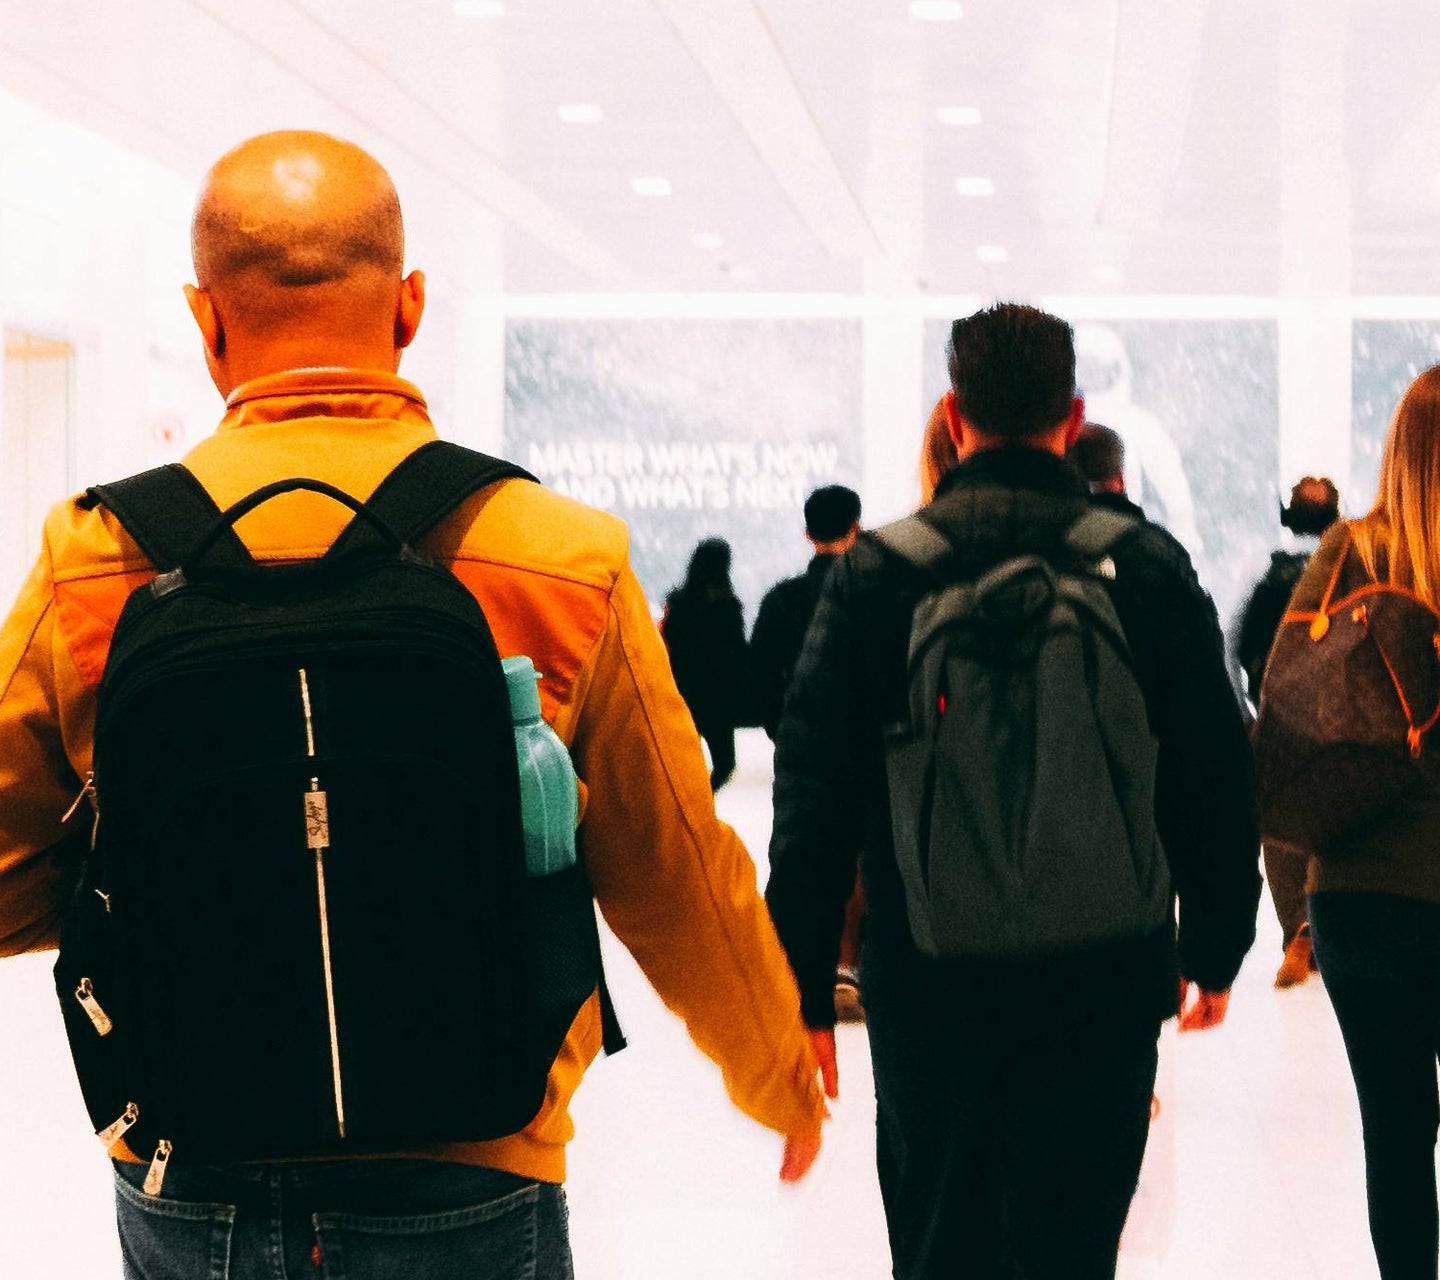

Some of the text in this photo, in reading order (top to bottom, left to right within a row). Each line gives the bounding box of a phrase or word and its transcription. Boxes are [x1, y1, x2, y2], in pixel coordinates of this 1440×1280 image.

[530, 442, 839, 477] MASTER WHAT'S NOW
[554, 476, 808, 510] AND WHAT'S NEXT
